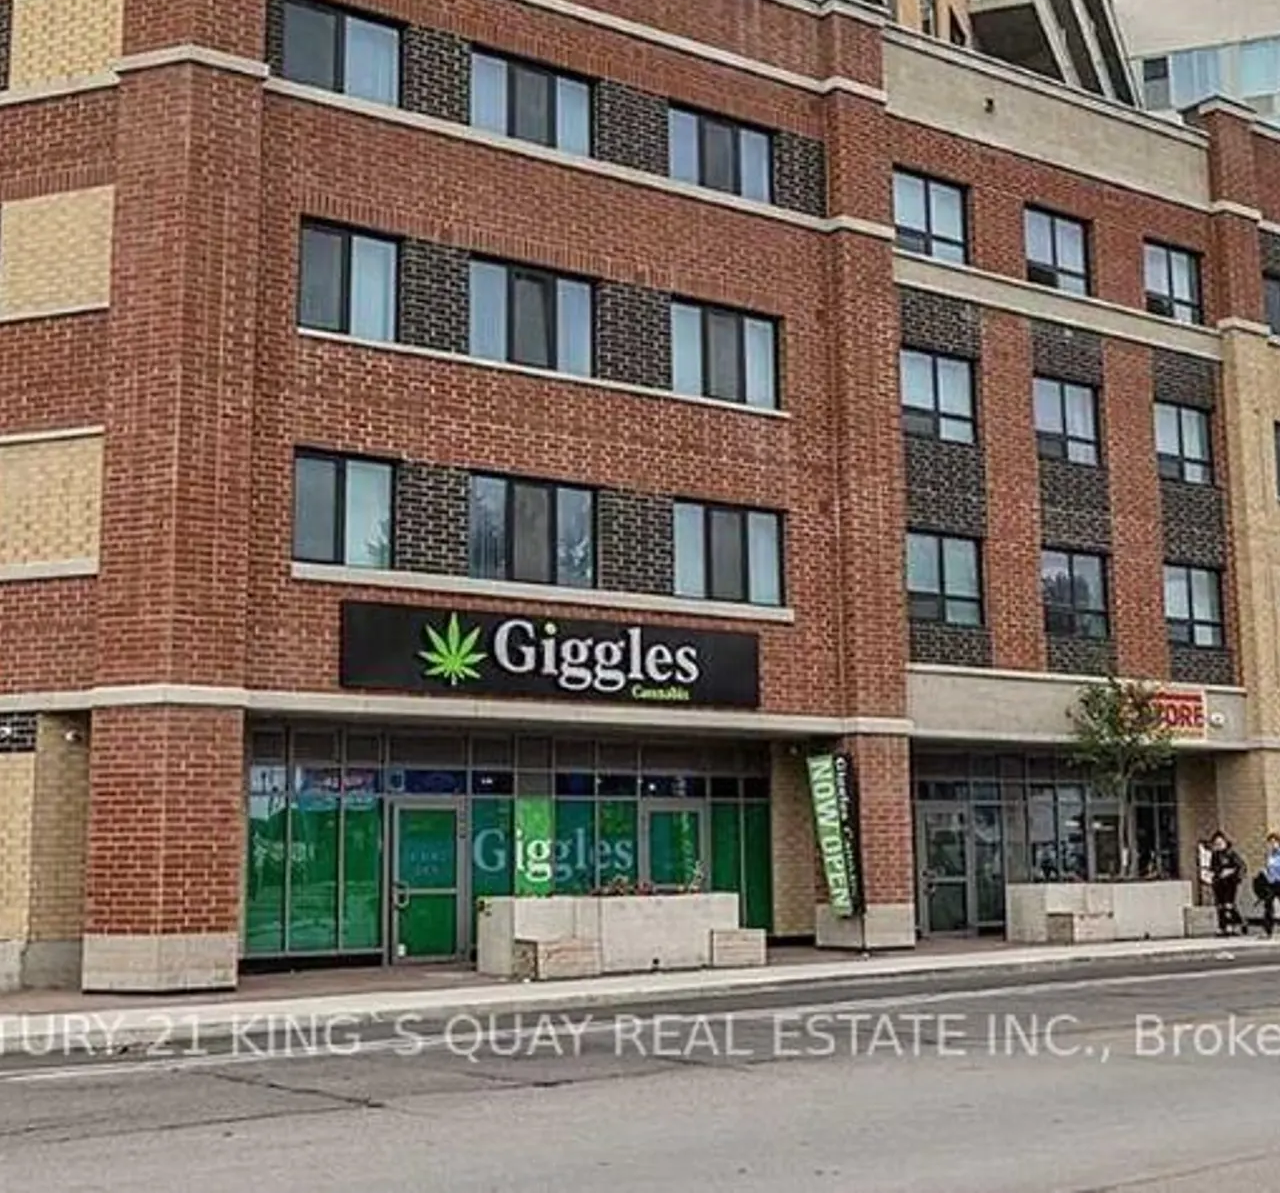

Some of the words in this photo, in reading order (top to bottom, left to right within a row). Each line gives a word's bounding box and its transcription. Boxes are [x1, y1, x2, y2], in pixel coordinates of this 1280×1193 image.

[493, 618, 700, 692] Giggles
[631, 684, 690, 701] Cannabis
[810, 759, 841, 827] NOW
[473, 826, 633, 883] Giggles
[821, 835, 851, 908] OPEN
